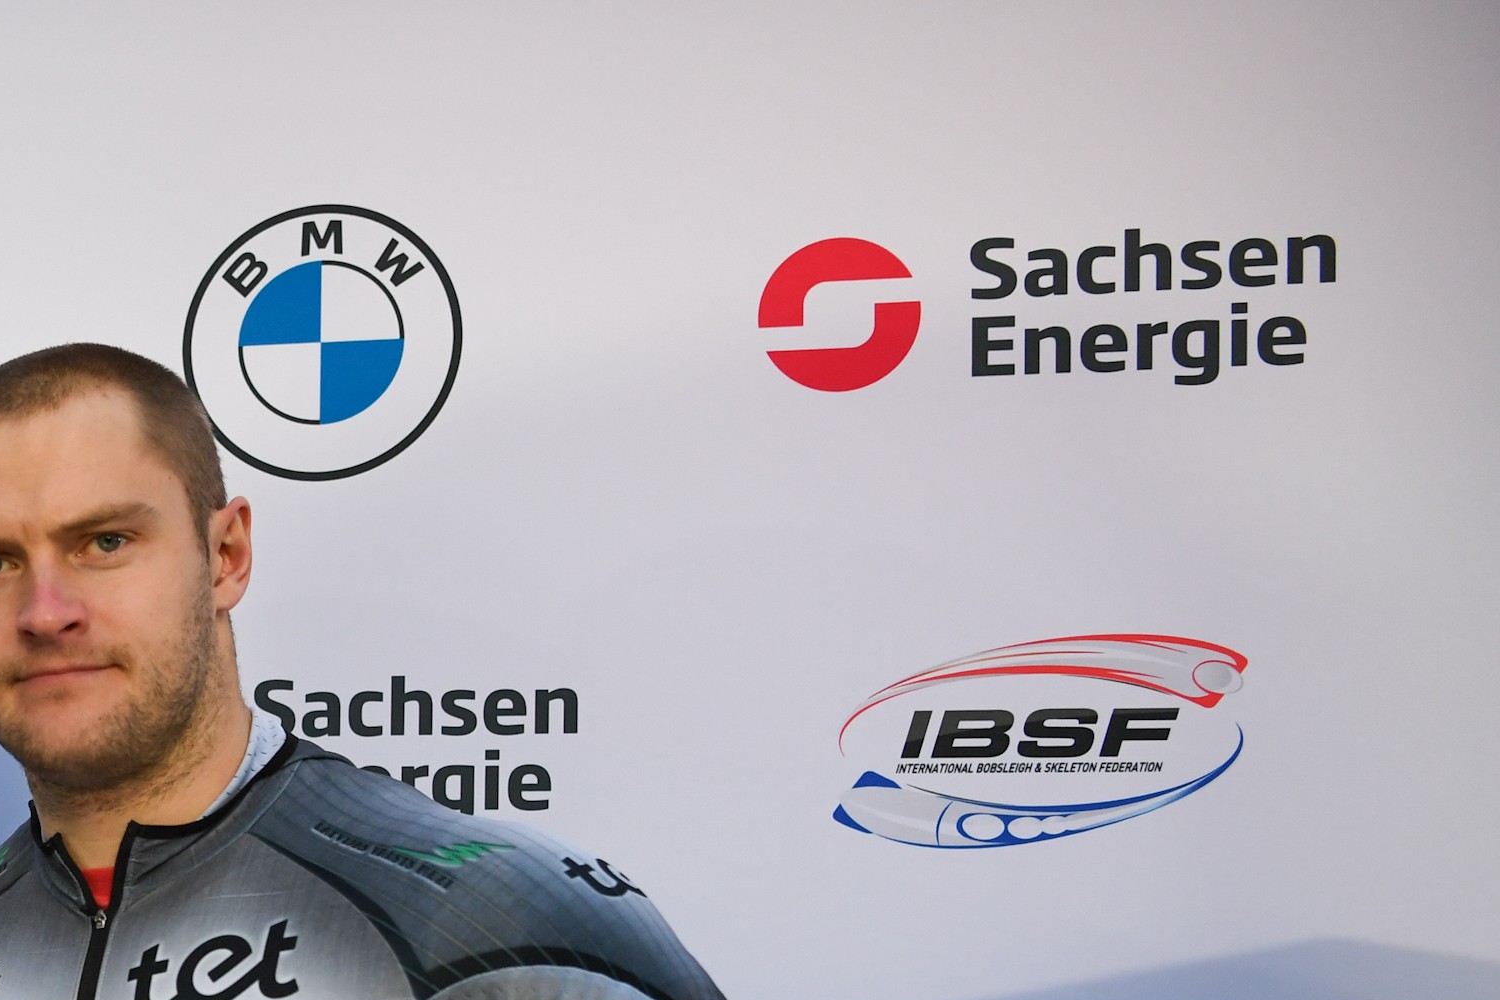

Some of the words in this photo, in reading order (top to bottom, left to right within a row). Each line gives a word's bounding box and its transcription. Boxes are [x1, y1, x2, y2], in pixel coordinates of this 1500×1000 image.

[222, 220, 425, 297] BMW
[970, 228, 1337, 300] Sachsen
[971, 302, 1307, 385] Energie
[253, 675, 579, 737] Sachsen
[900, 707, 1180, 759] IBSF
[896, 762, 974, 774] INTERNATIONAL
[976, 762, 1032, 774] BOBSLEIGH
[1034, 762, 1042, 773] &
[1044, 762, 1098, 773] SKELETON
[1099, 761, 1164, 773] FEDERATION
